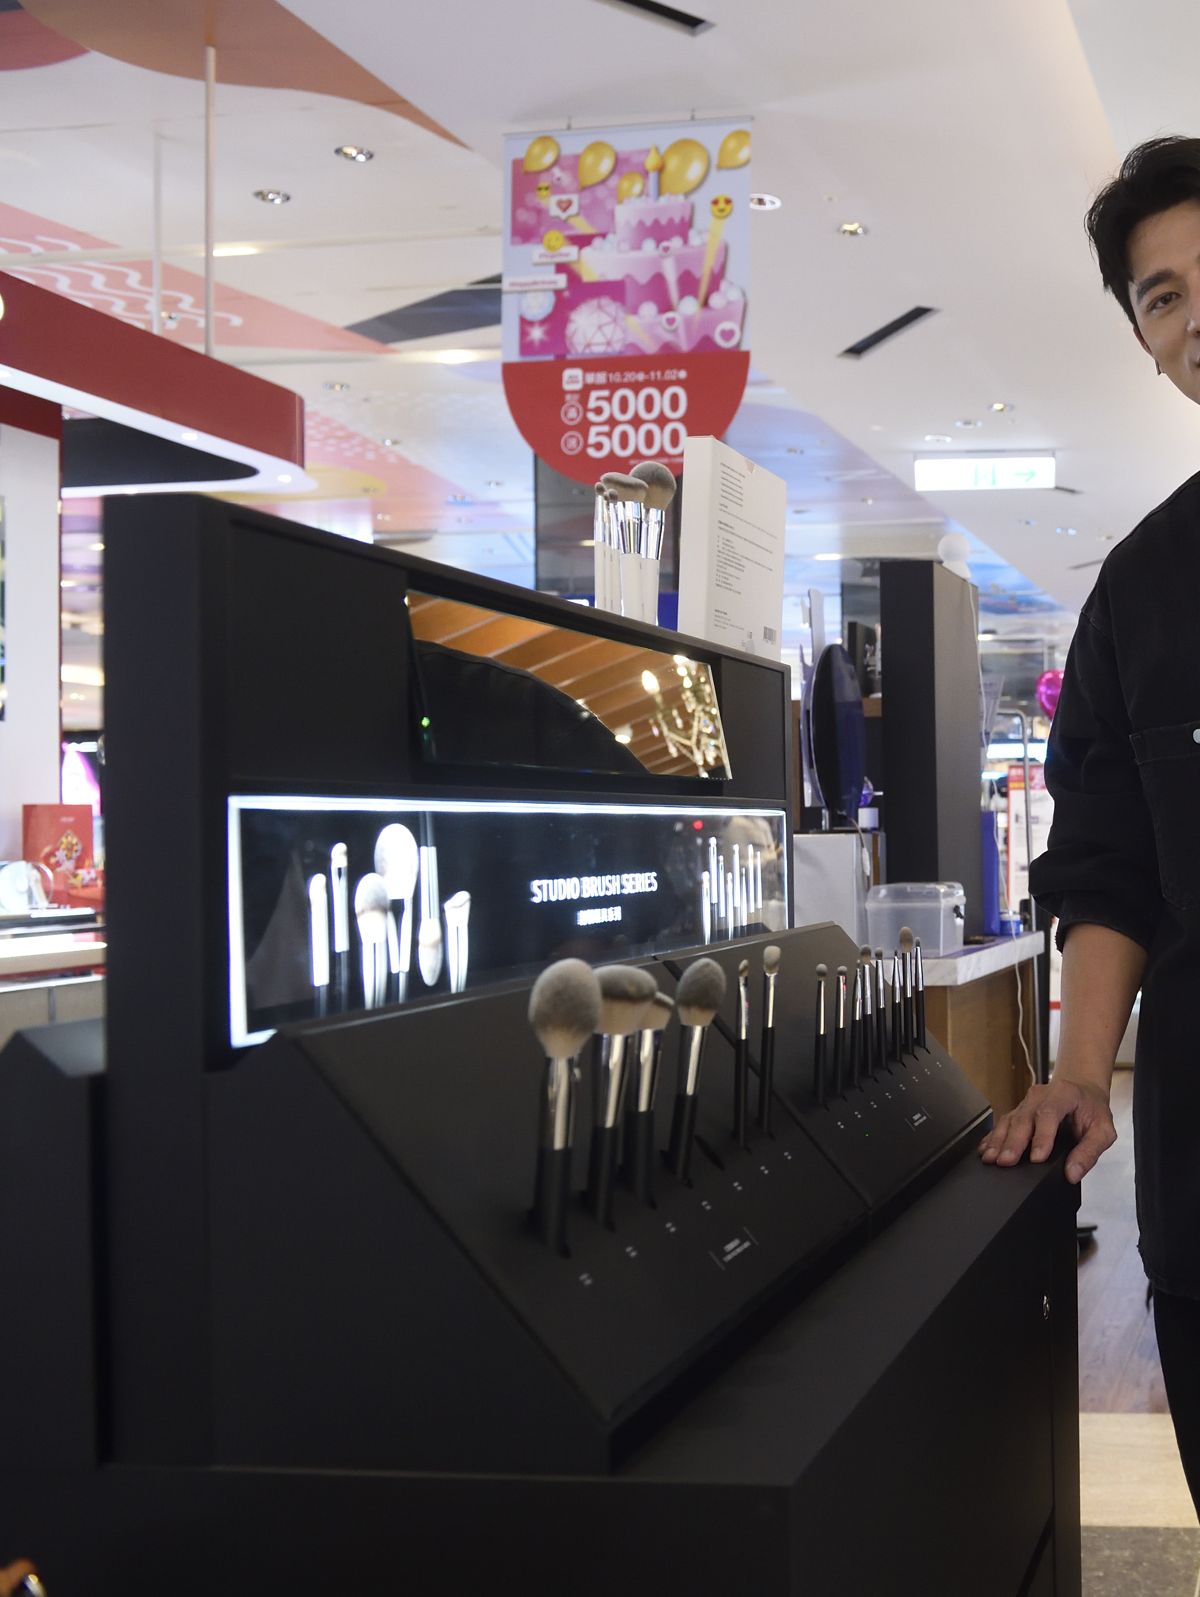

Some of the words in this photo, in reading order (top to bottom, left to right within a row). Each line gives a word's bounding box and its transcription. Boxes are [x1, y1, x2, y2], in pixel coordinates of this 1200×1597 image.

[586, 386, 688, 423] 5000
[586, 421, 687, 459] 5000
[530, 876, 580, 903] STUDIO
[580, 874, 620, 898] BRUSH
[620, 871, 658, 894] SERIES
